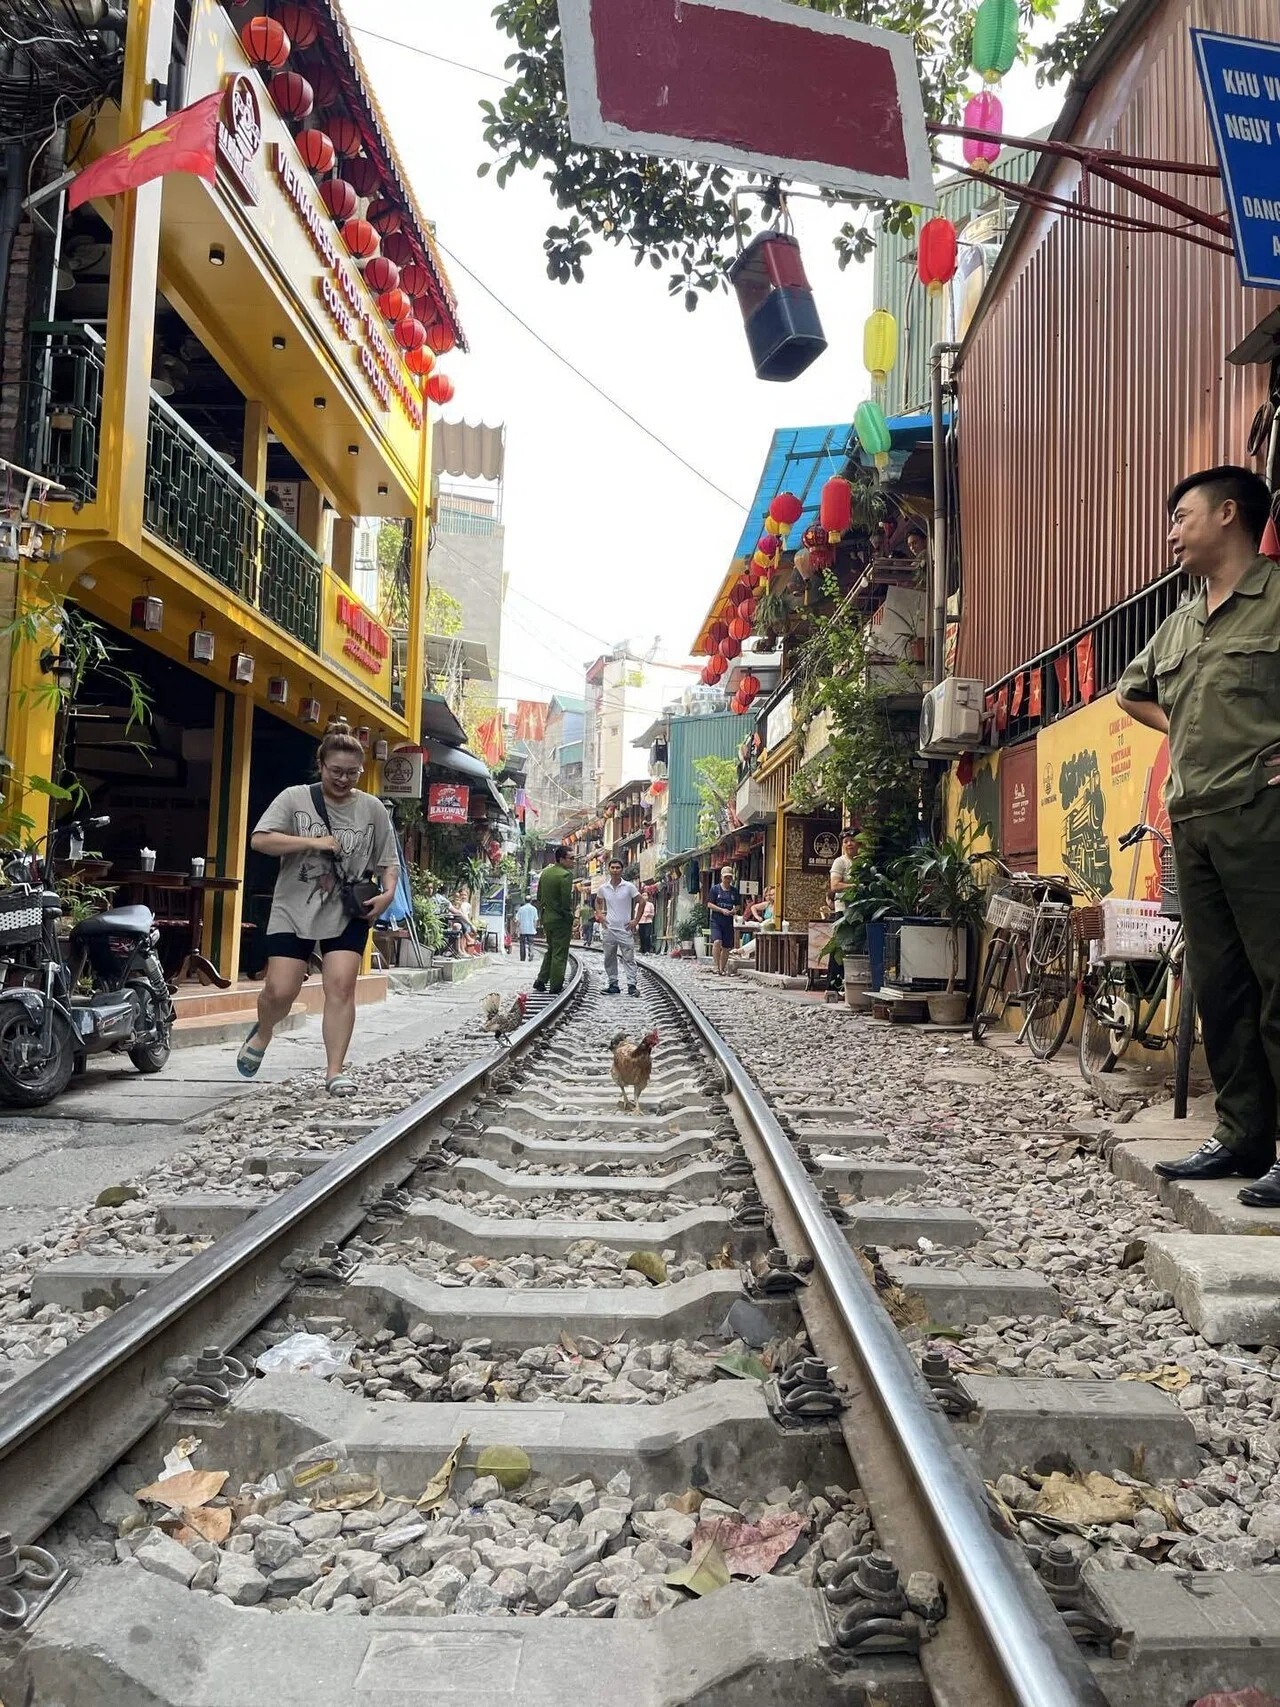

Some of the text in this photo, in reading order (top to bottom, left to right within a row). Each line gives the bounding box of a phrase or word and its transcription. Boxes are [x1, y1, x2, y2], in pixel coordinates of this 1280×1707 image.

[1222, 68, 1260, 99] KHU
[1224, 113, 1272, 146] NGUY
[1117, 733, 1125, 747] TO
[1112, 771, 1131, 787] HISTORY
[430, 806, 466, 816] RAILWAY
